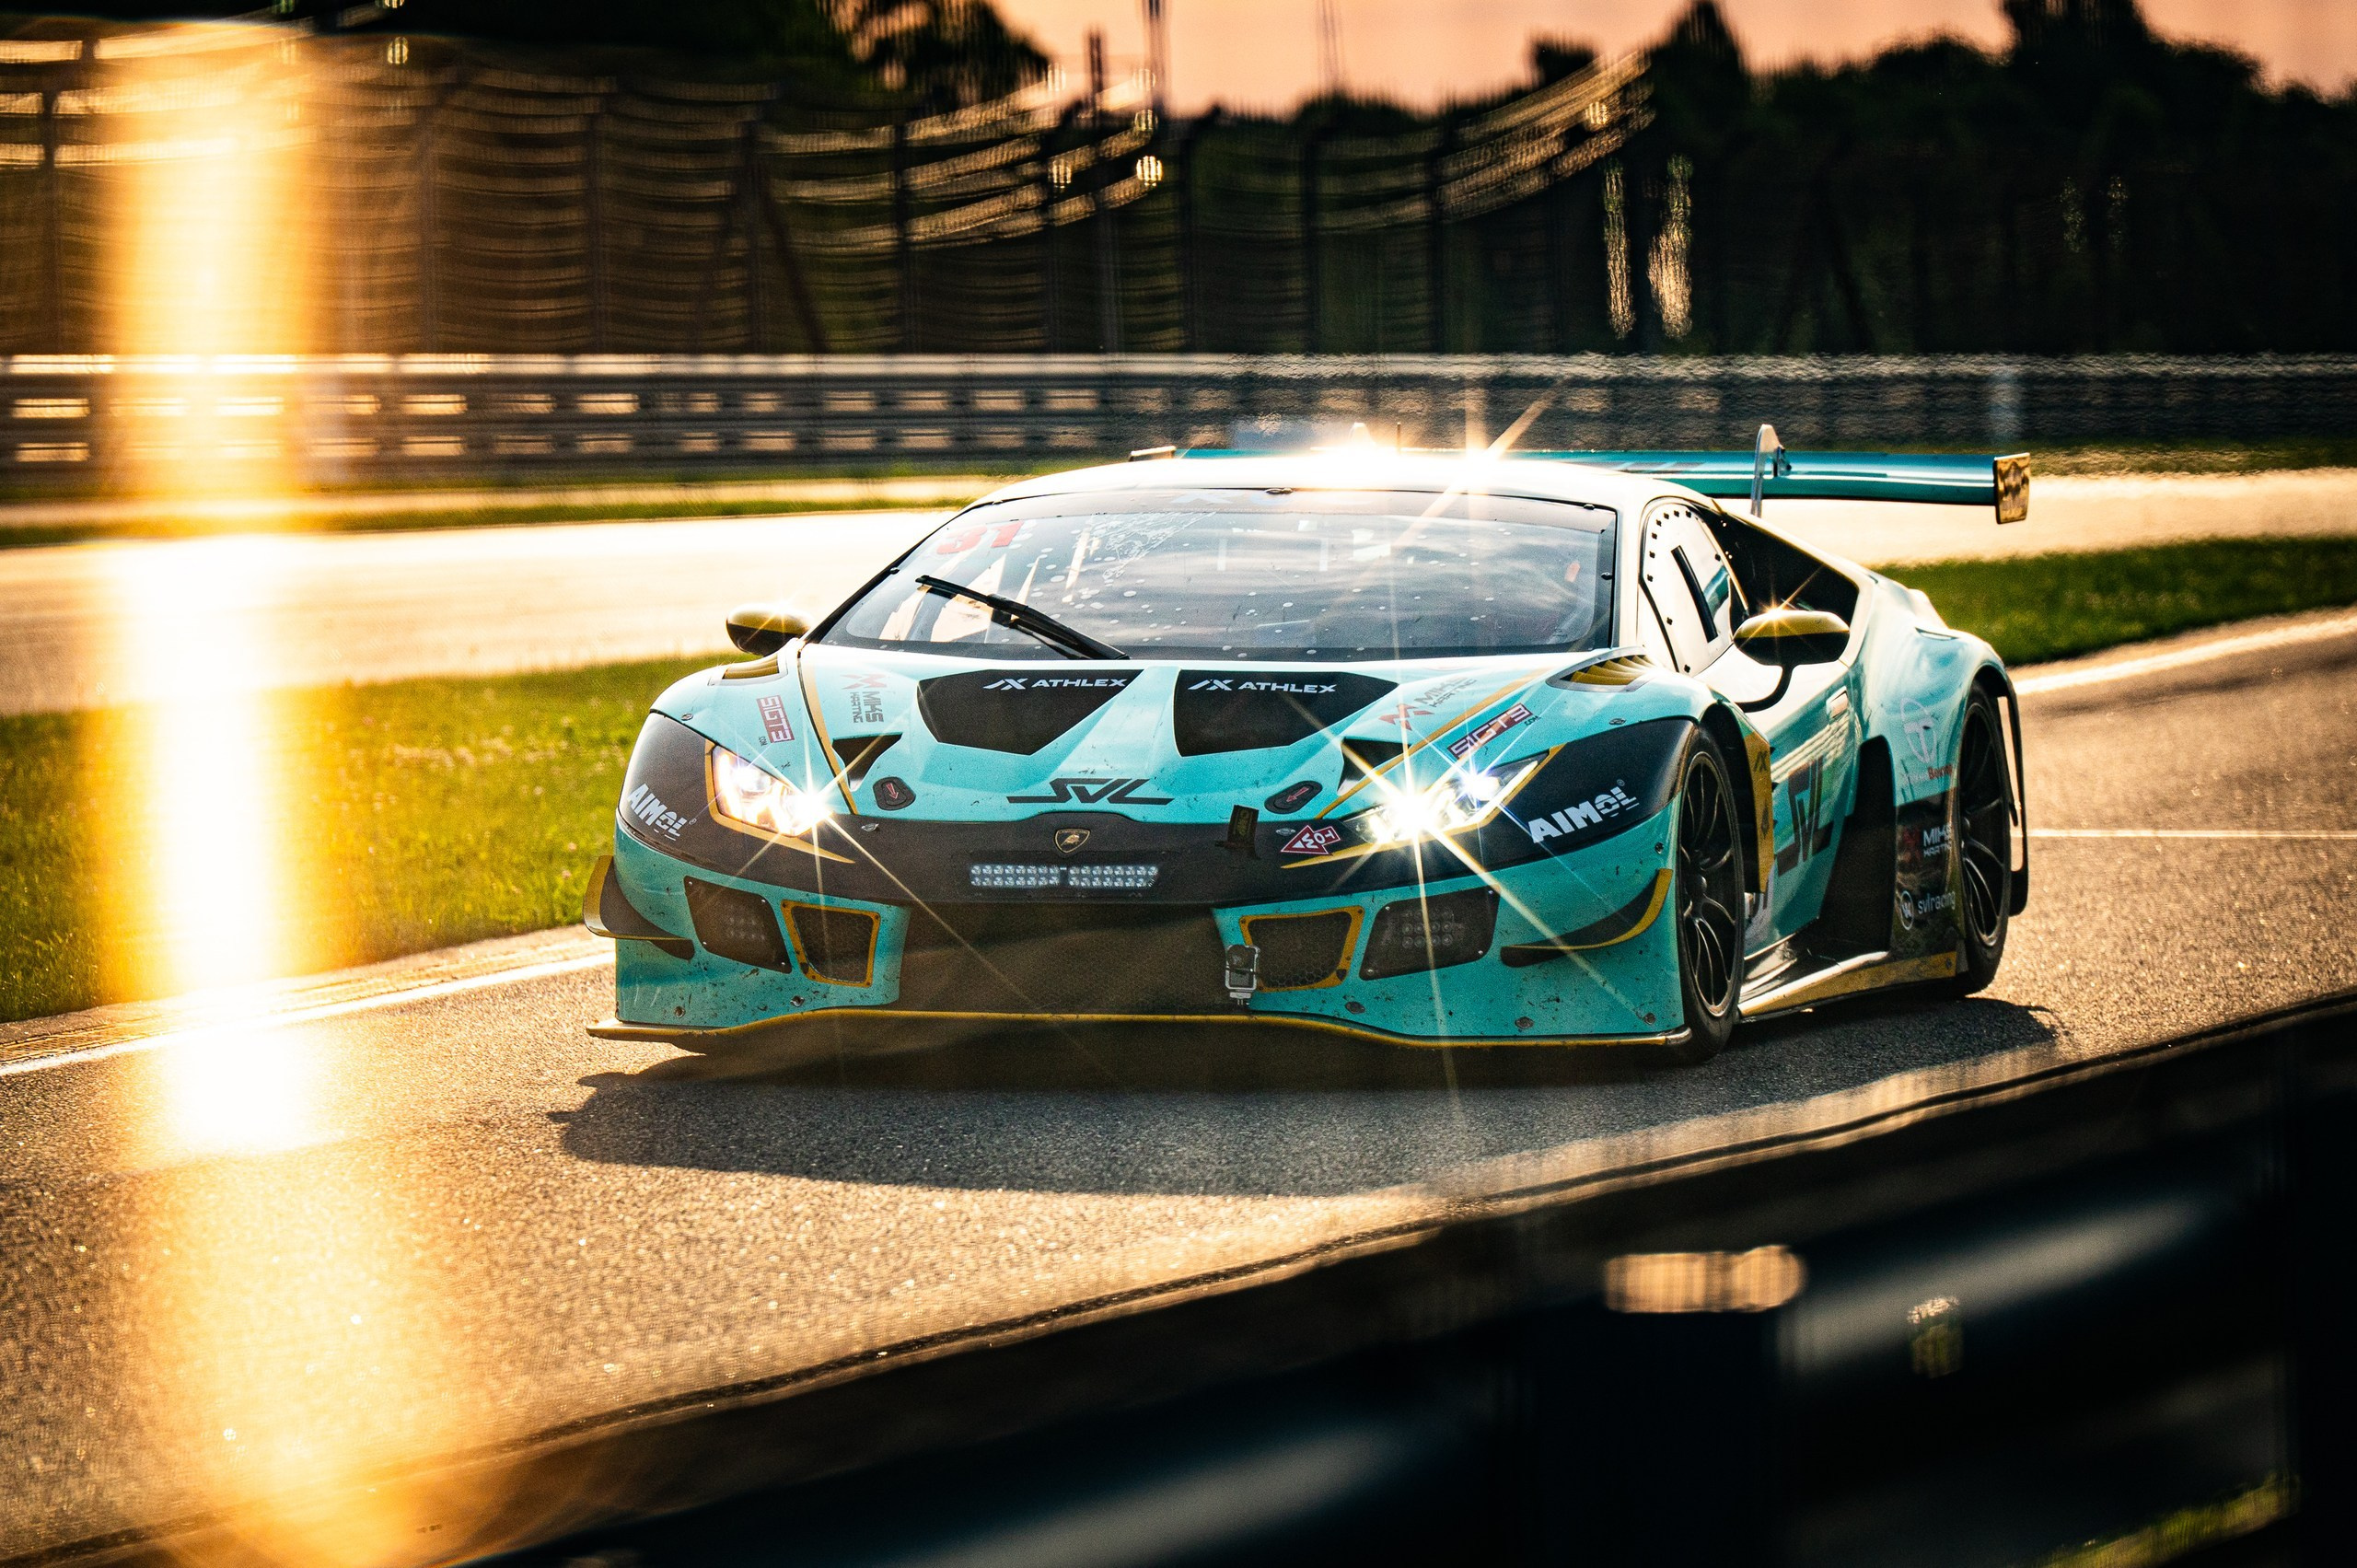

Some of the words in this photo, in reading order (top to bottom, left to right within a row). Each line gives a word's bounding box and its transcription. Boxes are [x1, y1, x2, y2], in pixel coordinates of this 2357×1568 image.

[1031, 679, 1127, 688] ATHLEX
[1237, 681, 1338, 693] ATHLEX
[1005, 778, 1175, 806] SVL
[627, 784, 688, 841] AIMOL
[1528, 786, 1640, 843] AIMOL
[1301, 830, 1335, 850] TOW
